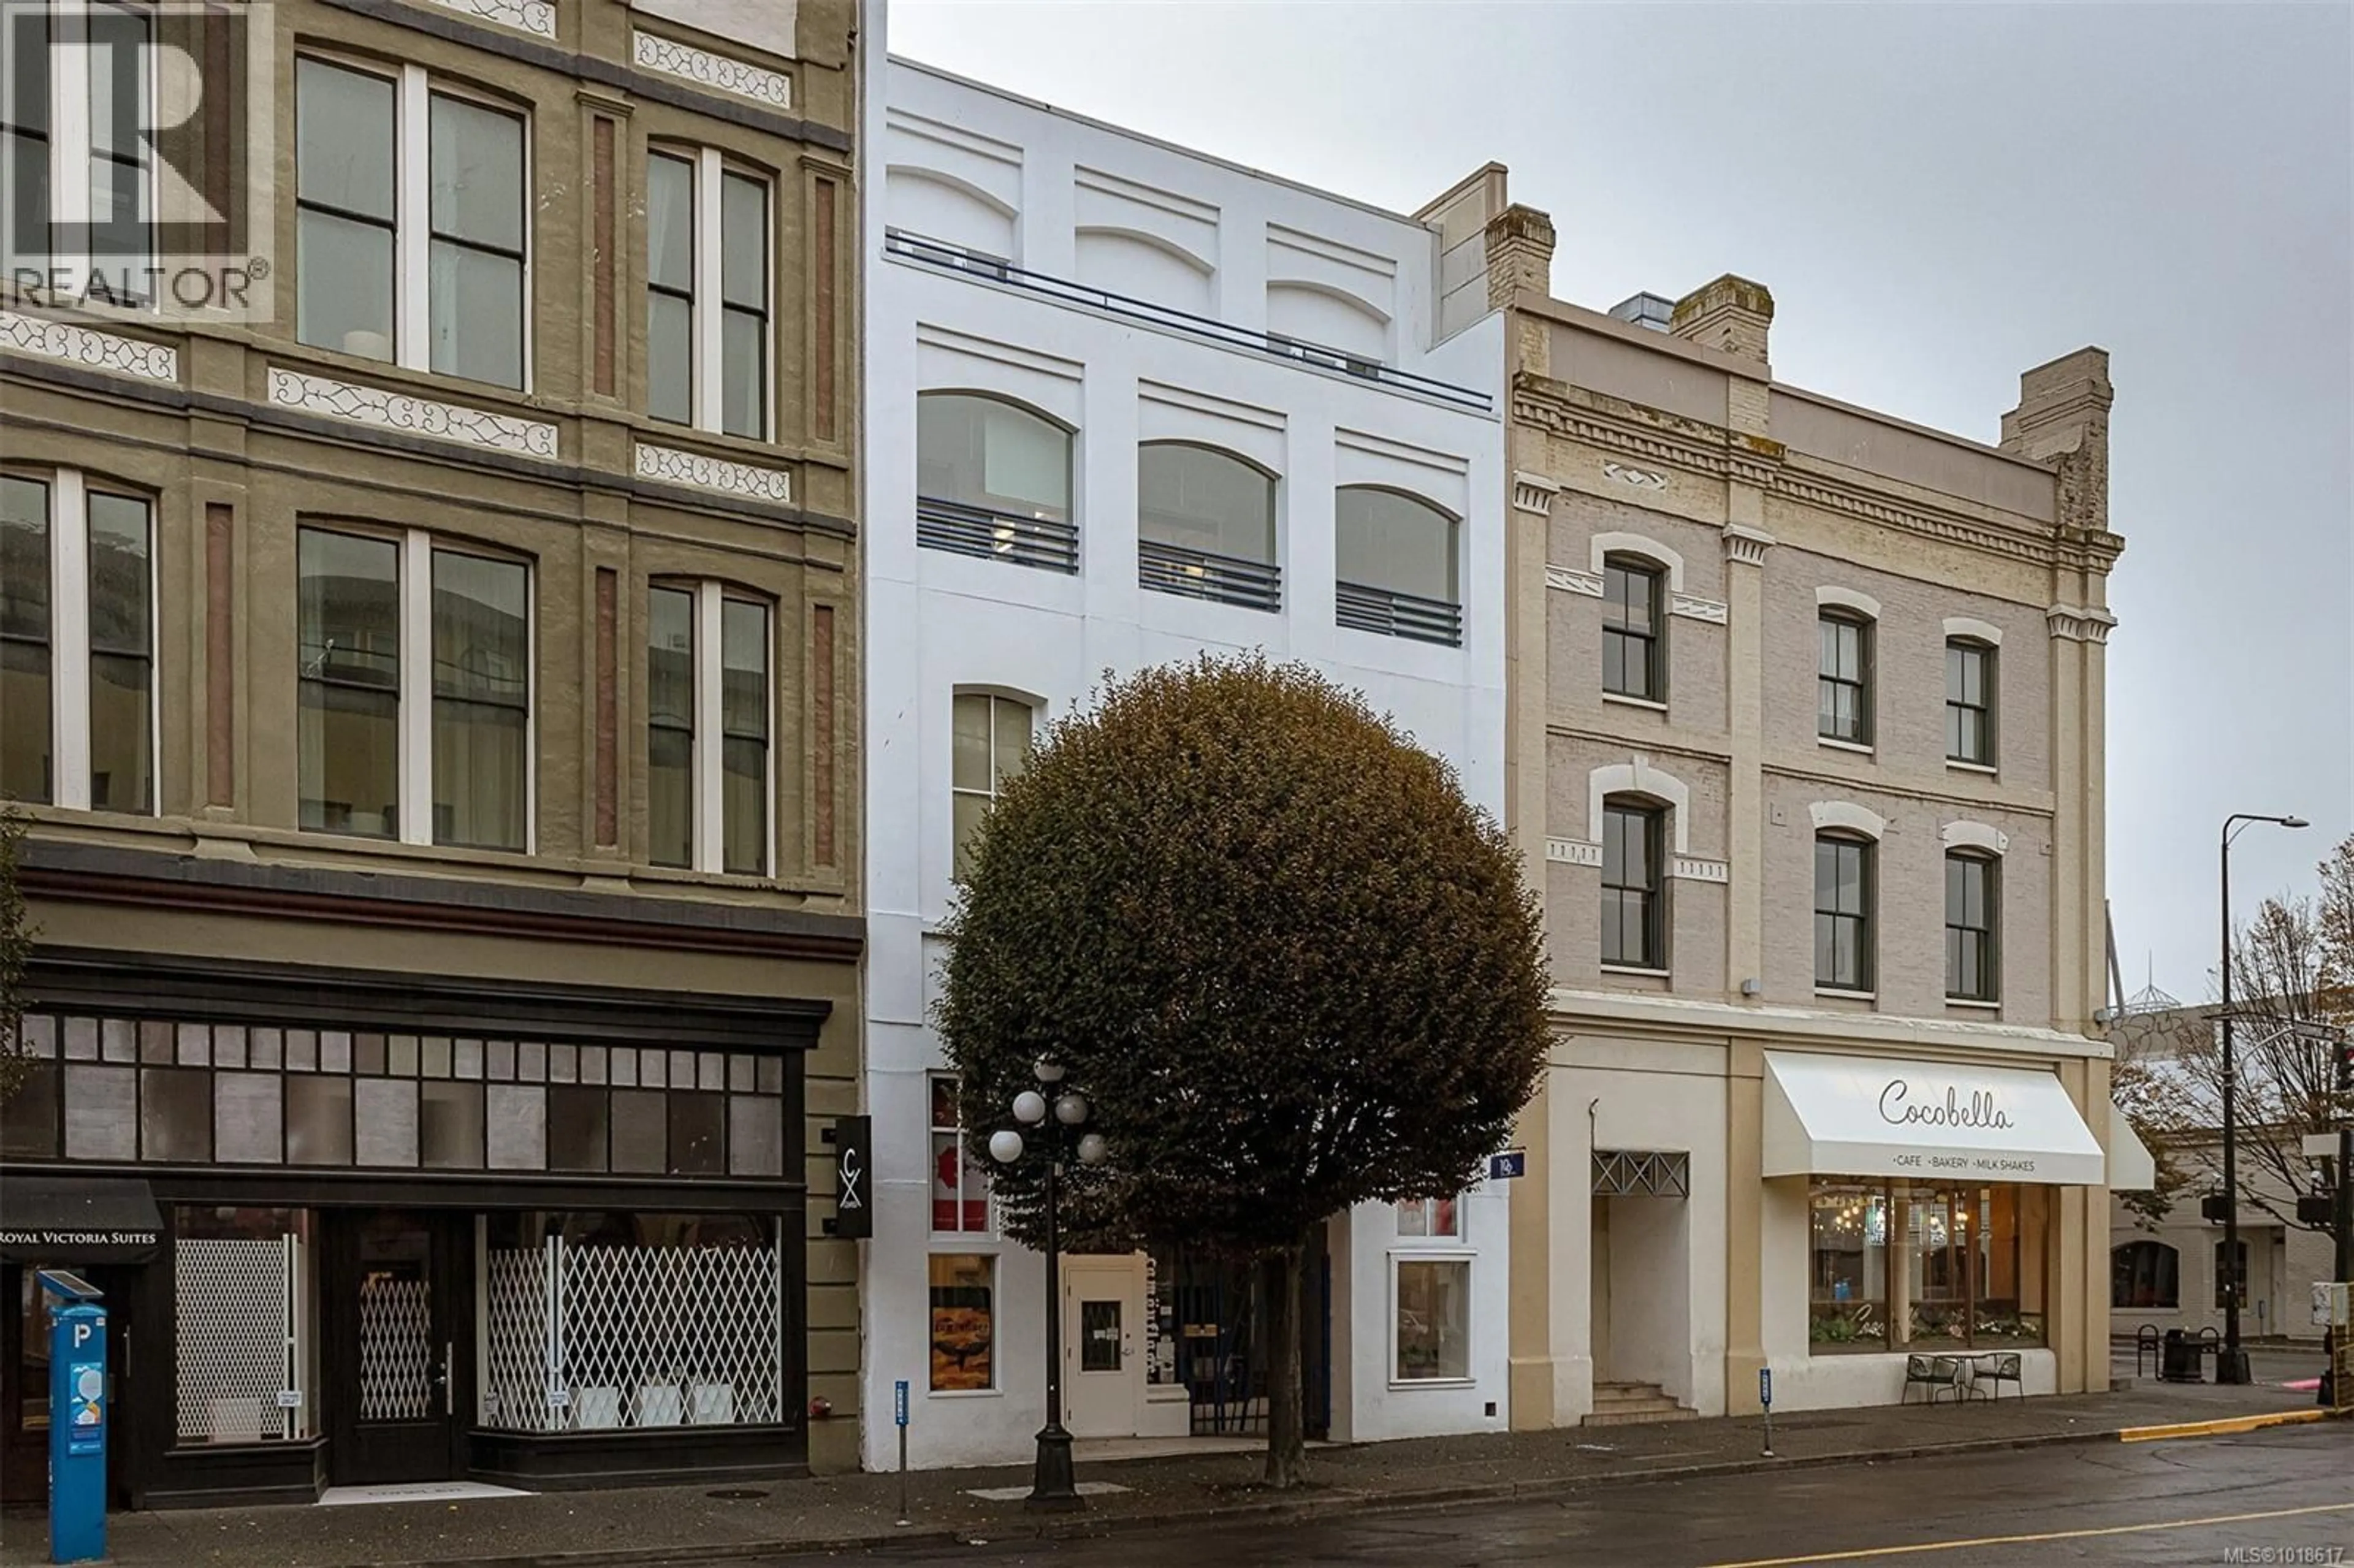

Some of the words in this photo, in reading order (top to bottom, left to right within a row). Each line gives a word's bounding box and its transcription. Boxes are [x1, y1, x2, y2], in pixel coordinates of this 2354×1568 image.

[1879, 1079, 2014, 1128] Cocobella
[43, 1231, 108, 1244] VICTORIA
[112, 1232, 156, 1244] SUITES
[74, 1323, 91, 1348] P
